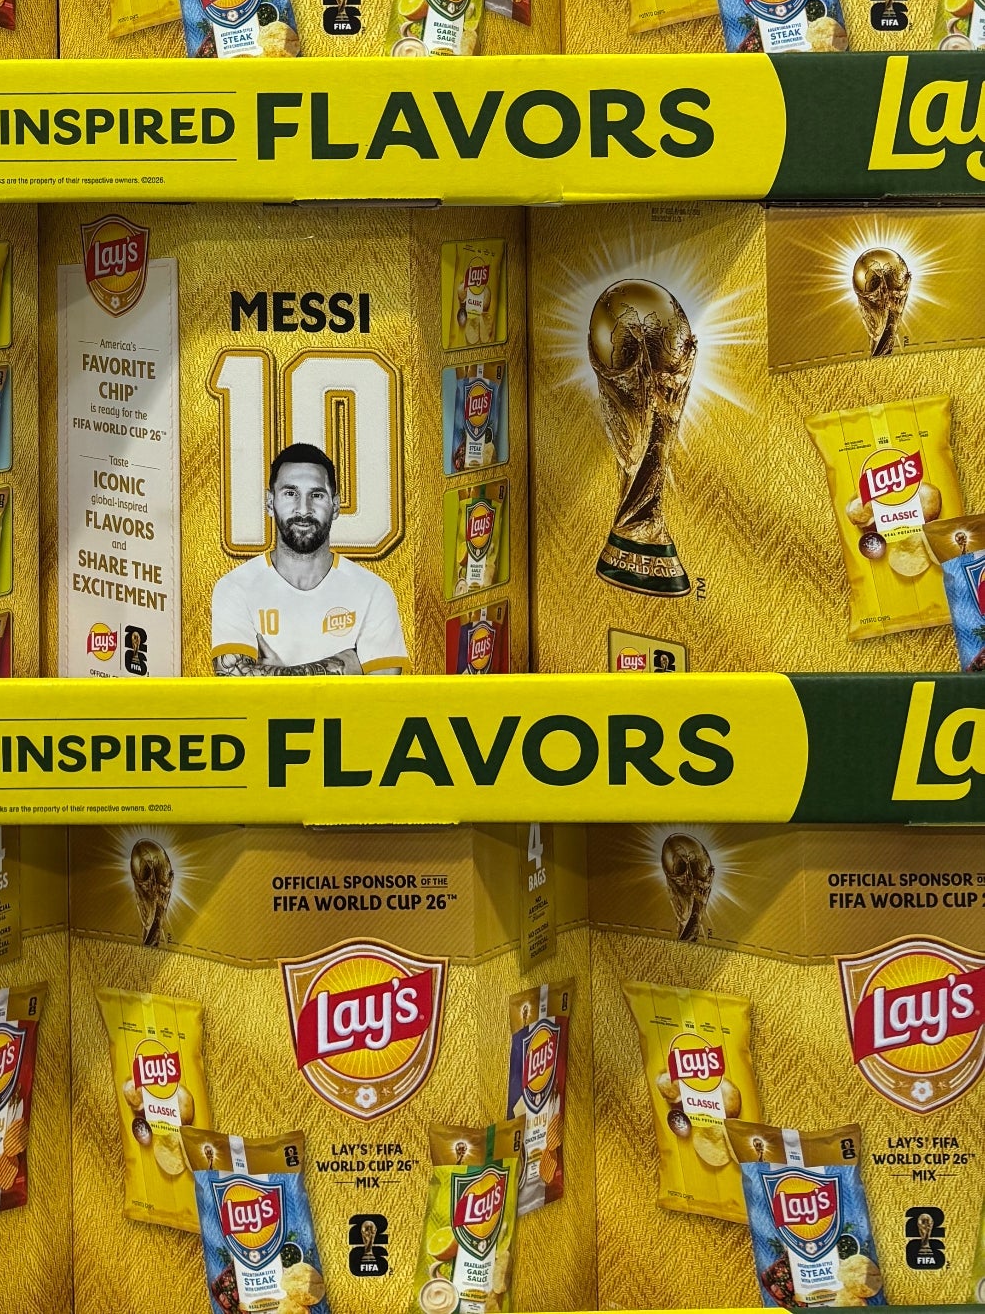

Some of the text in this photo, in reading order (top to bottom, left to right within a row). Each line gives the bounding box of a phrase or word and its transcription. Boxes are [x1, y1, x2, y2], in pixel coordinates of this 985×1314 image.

[770, 28, 802, 40] STEAK
[258, 88, 715, 160] FLAVORS
[95, 236, 138, 277] Lay's
[230, 292, 370, 333] MESSI
[100, 339, 136, 352] America's
[82, 354, 155, 379] FAVORITE
[90, 403, 147, 420] is ready for the
[73, 418, 91, 430] FIFA
[93, 421, 127, 436] WORLD
[129, 426, 148, 438] CUP
[109, 455, 128, 467] Taste
[94, 470, 145, 497] ICONIC
[865, 457, 918, 498] Lay's
[91, 494, 148, 513] global-inspired
[86, 510, 154, 540] FLAVORS
[881, 510, 918, 523] CLASSIC
[112, 540, 126, 550] and
[79, 549, 163, 584] SHARE THE
[73, 573, 167, 611] EXCITEMENT
[258, 609, 279, 636] 10
[91, 628, 114, 653] Lay's
[621, 655, 644, 669] Lay's
[268, 714, 733, 787] FLAVORS
[272, 875, 448, 890] OFFICIAL SPONSOR OF THE
[273, 895, 310, 912] FIFA
[315, 895, 382, 911] WORLD
[386, 895, 422, 910] CUP
[317, 978, 418, 1053] Lay's
[873, 974, 975, 1049] Lay's
